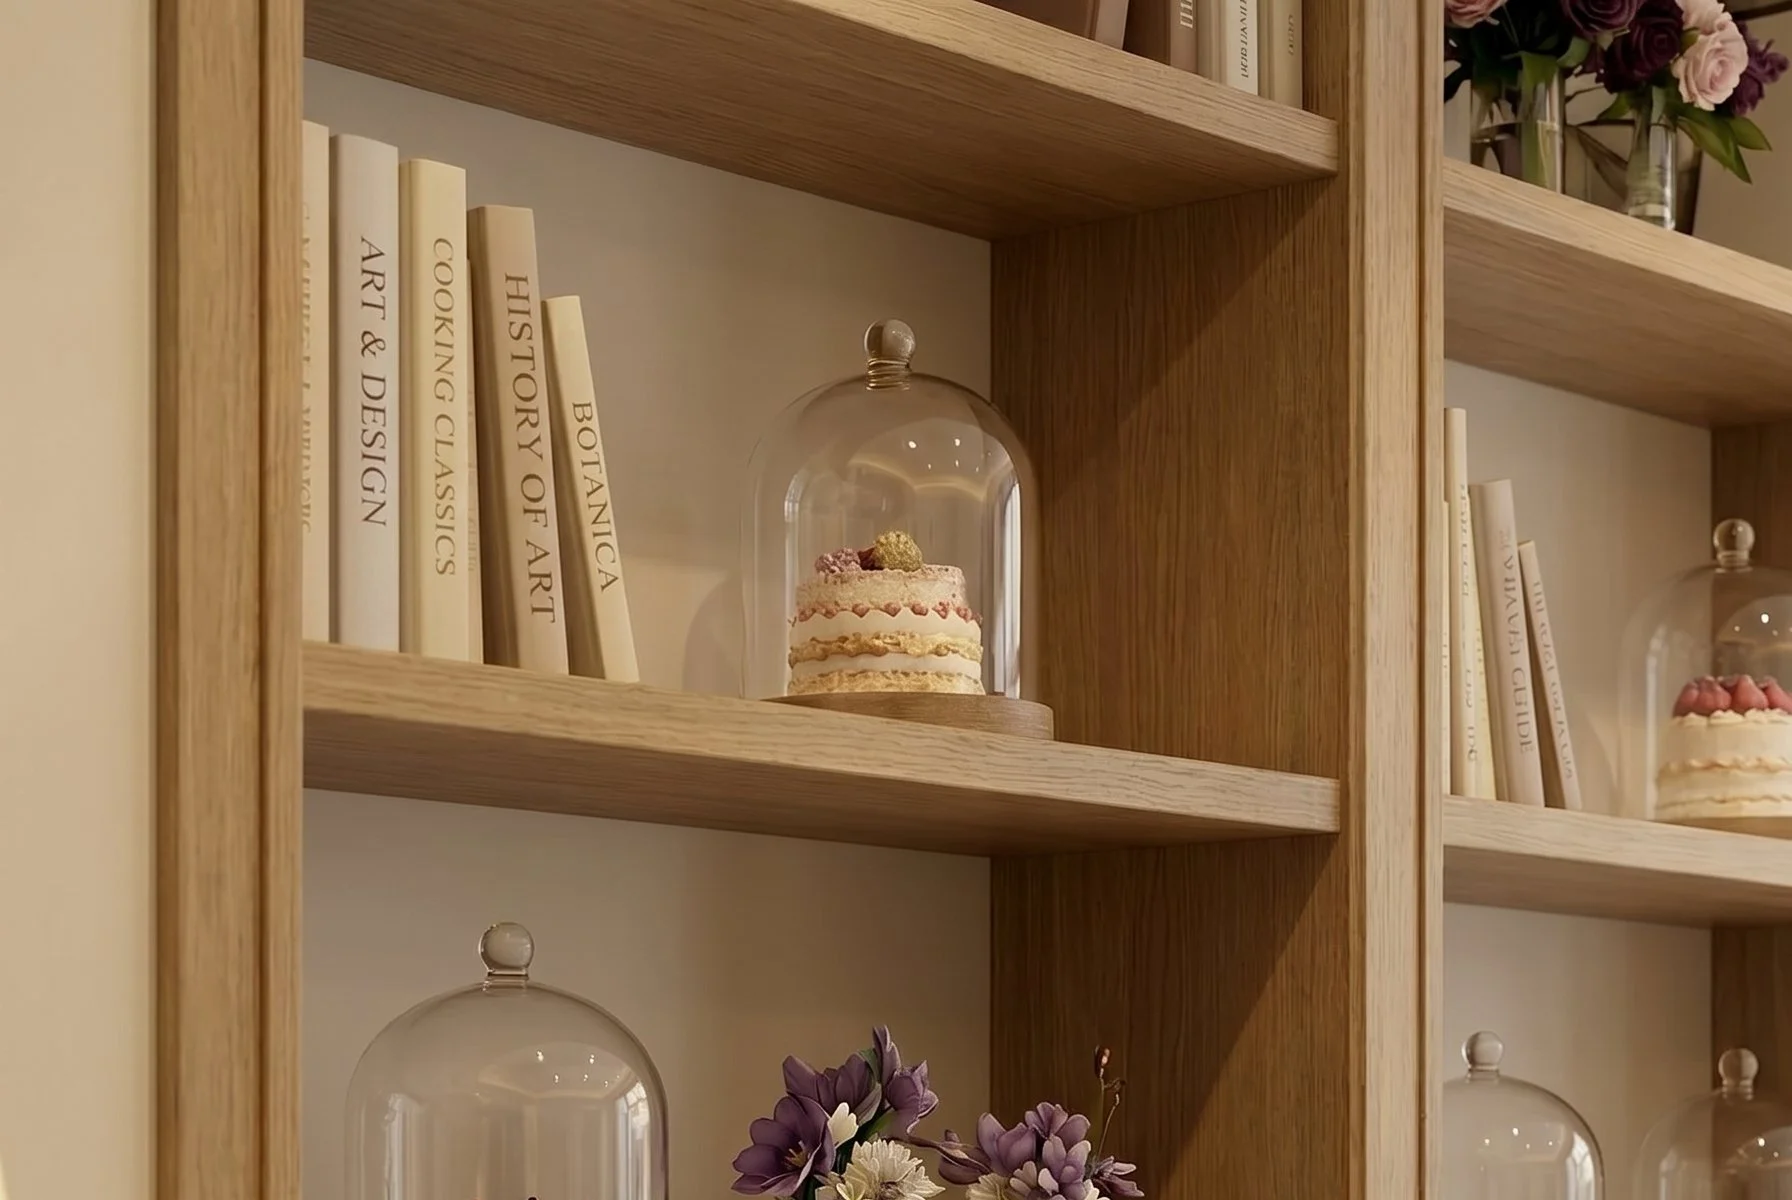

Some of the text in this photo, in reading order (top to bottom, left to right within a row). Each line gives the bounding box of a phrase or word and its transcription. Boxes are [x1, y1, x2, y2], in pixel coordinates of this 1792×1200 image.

[360, 236, 388, 526] ART & DESIGN
[432, 237, 456, 577] COOKING CLASSICS
[504, 272, 556, 624] HISTORY OF ART
[572, 401, 620, 593] BOTANICA
